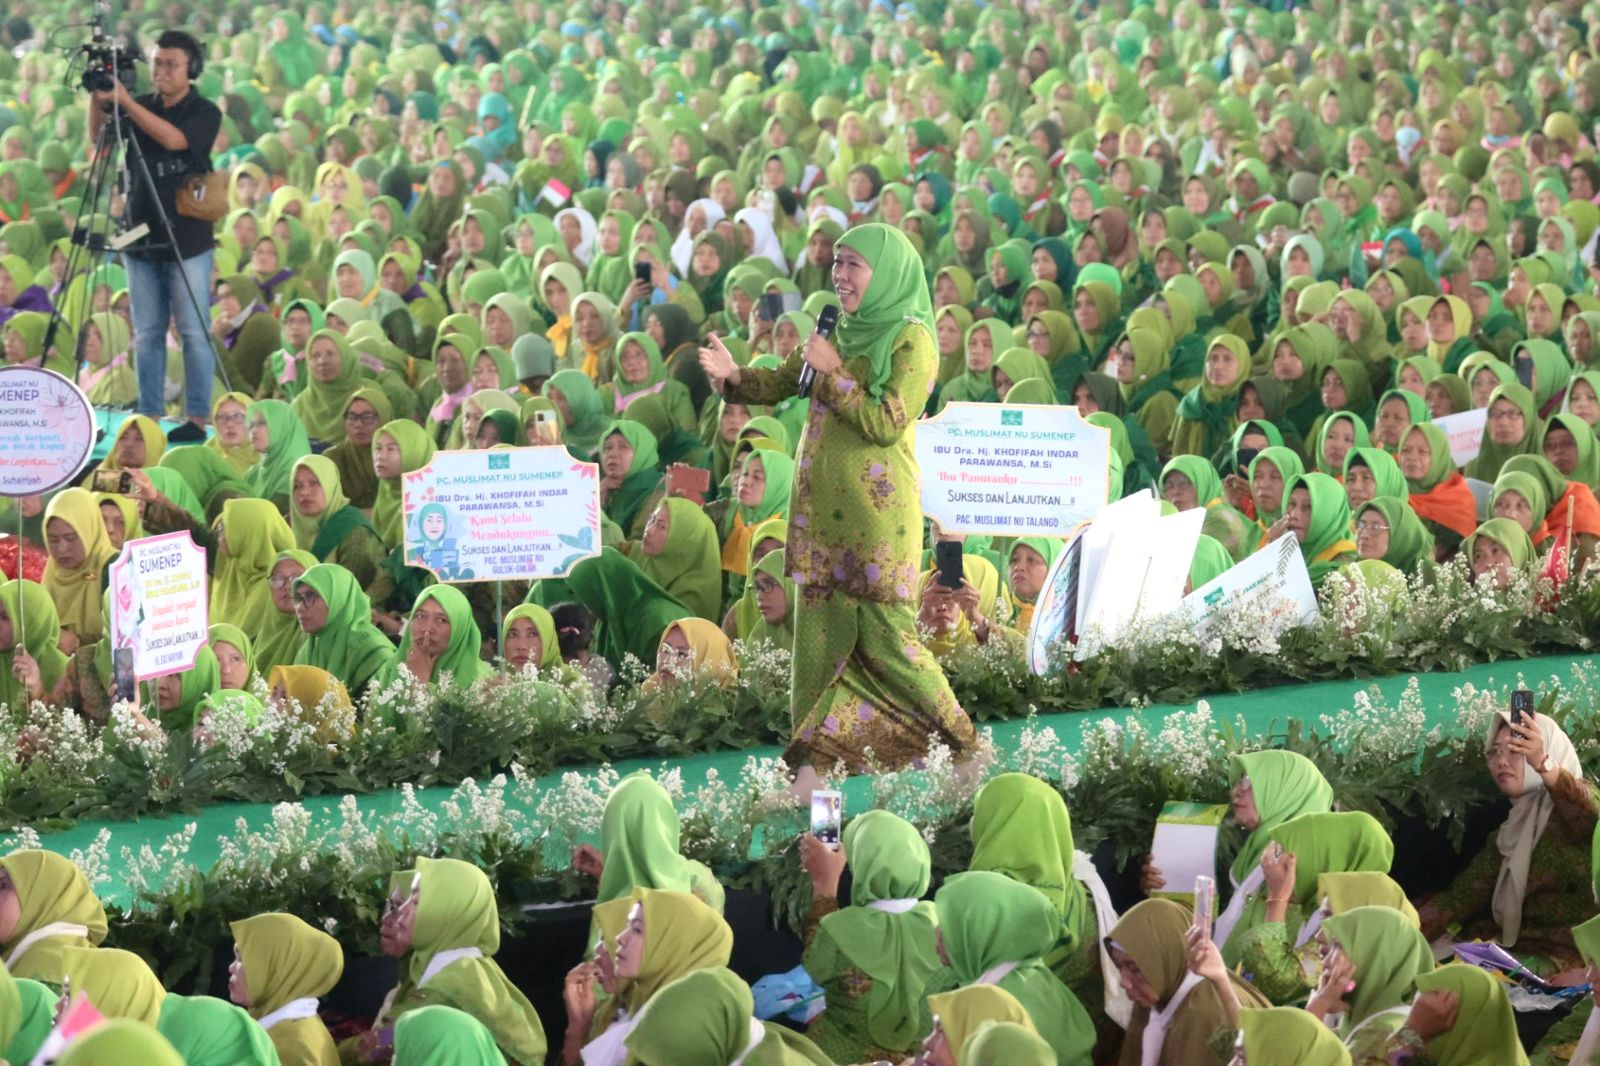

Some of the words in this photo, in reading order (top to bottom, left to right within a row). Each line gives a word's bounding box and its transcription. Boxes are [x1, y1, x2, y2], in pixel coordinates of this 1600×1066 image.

[964, 429, 1013, 438] MUSLIMAT
[1015, 430, 1028, 439] NU
[1030, 431, 1076, 440] SUMENEP
[934, 445, 951, 454] IBU
[954, 446, 974, 455] Dra.
[994, 447, 1044, 457] KHOFIFAH
[1047, 449, 1079, 459] INDAR
[959, 457, 1027, 468] PARAWANSA,
[1030, 460, 1052, 469] M.Si
[453, 474, 501, 484] MUSLIMAT
[503, 473, 517, 481] NU
[519, 471, 564, 480] SUMENEP
[937, 471, 957, 482] Ibu
[959, 471, 1018, 485] Panutanku
[436, 495, 451, 503] IBU
[490, 491, 536, 500] KHOFIFAH
[539, 488, 568, 497] INDAR
[947, 489, 984, 503] SUKSES
[985, 493, 1005, 503] DAN
[459, 501, 521, 511] PARAWANSA,
[469, 515, 498, 526] Kami
[974, 515, 1012, 526] MUSLIMAT
[1013, 516, 1024, 526] NU
[1026, 516, 1059, 527] TALANGO
[491, 545, 506, 553] DAN
[139, 552, 183, 574] SUMENEP
[500, 554, 533, 564] MUSLIMAT
